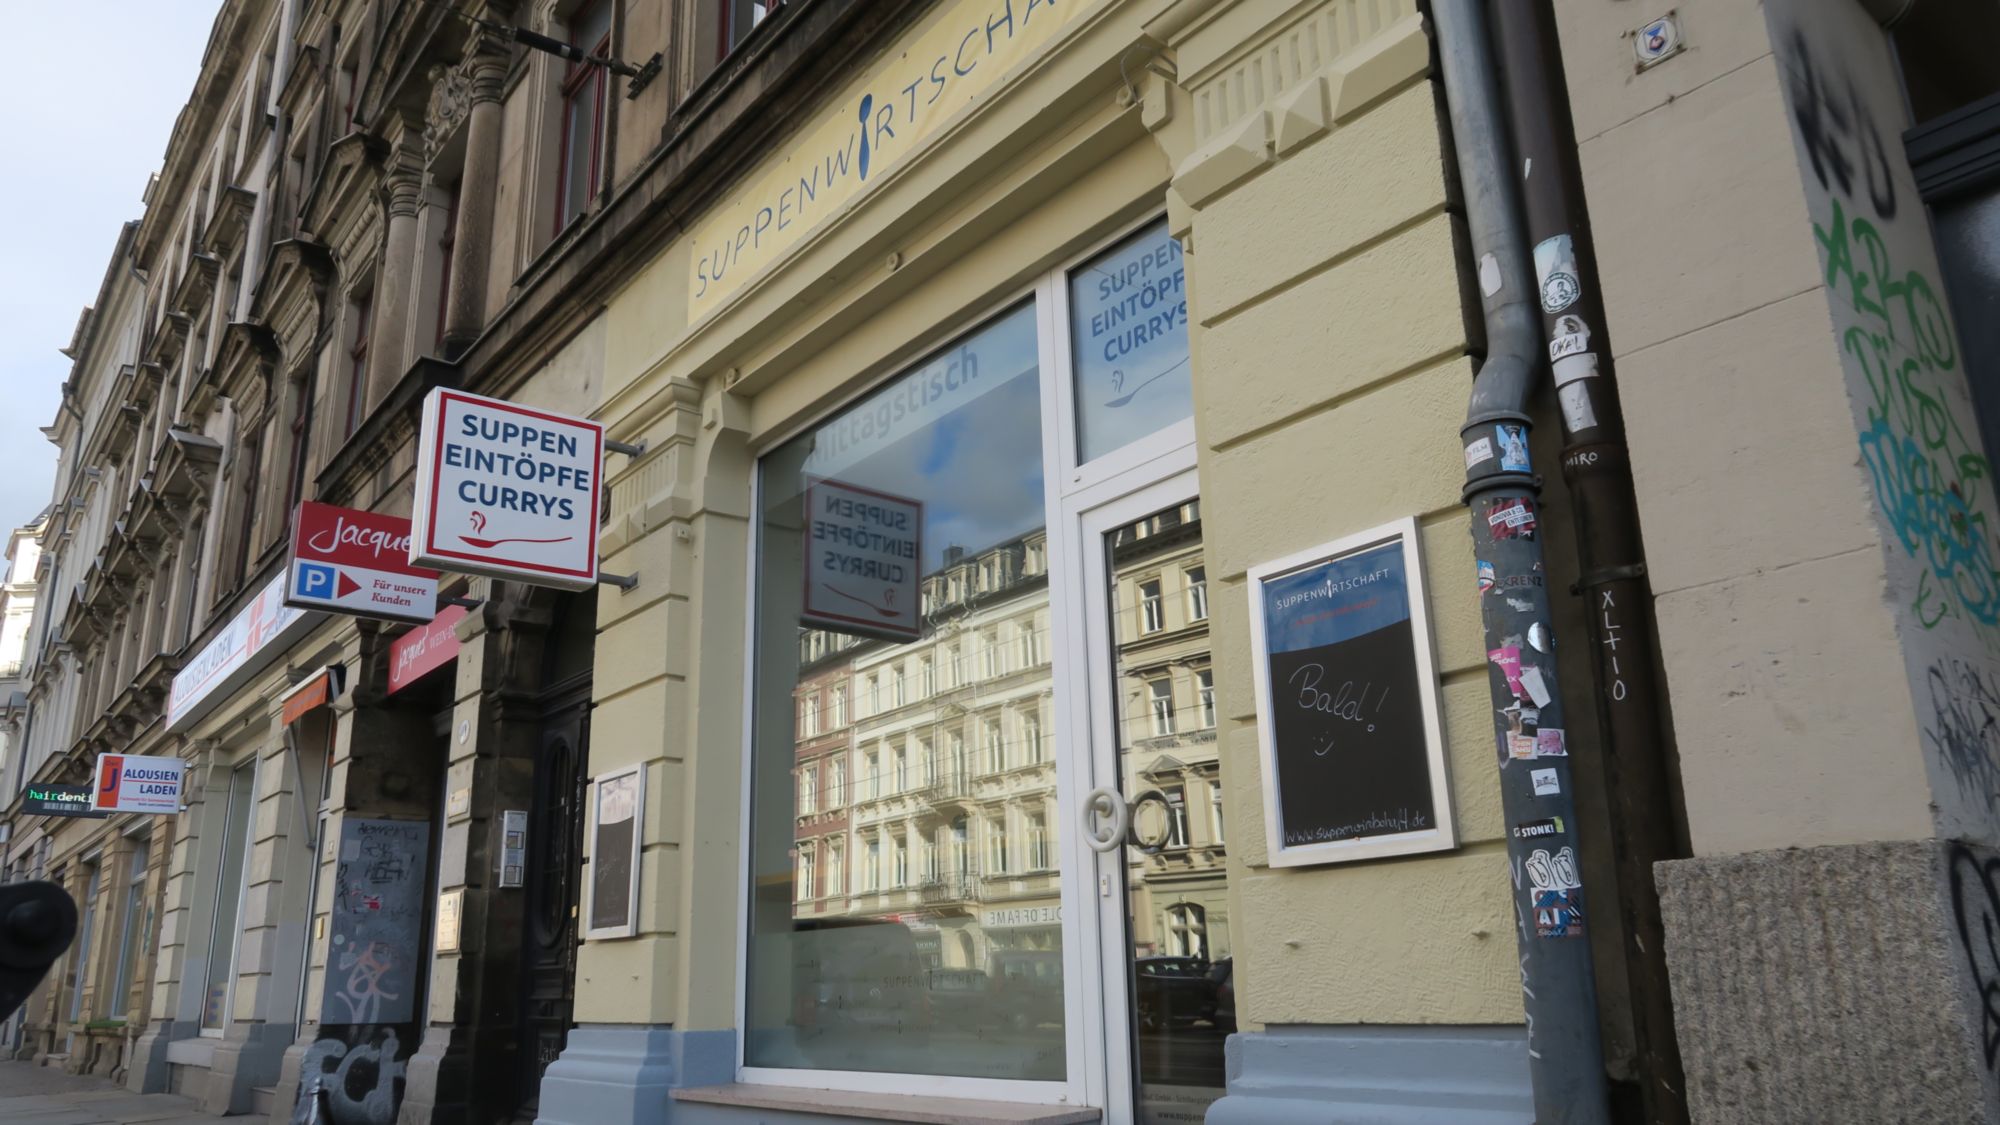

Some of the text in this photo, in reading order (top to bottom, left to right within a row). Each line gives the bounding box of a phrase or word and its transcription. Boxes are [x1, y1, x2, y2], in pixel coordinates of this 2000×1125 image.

[461, 413, 577, 458] SUPPEN
[445, 442, 590, 492] EINTÖPFE
[458, 479, 574, 520] CURRYS
[305, 568, 327, 593] P
[371, 592, 411, 607] Kunden
[373, 579, 427, 596] Für unsere
[1276, 568, 1390, 611] SUPPENWIRTSCHAFT
[1289, 663, 1391, 734] Bald!
[139, 784, 177, 796] LADEN
